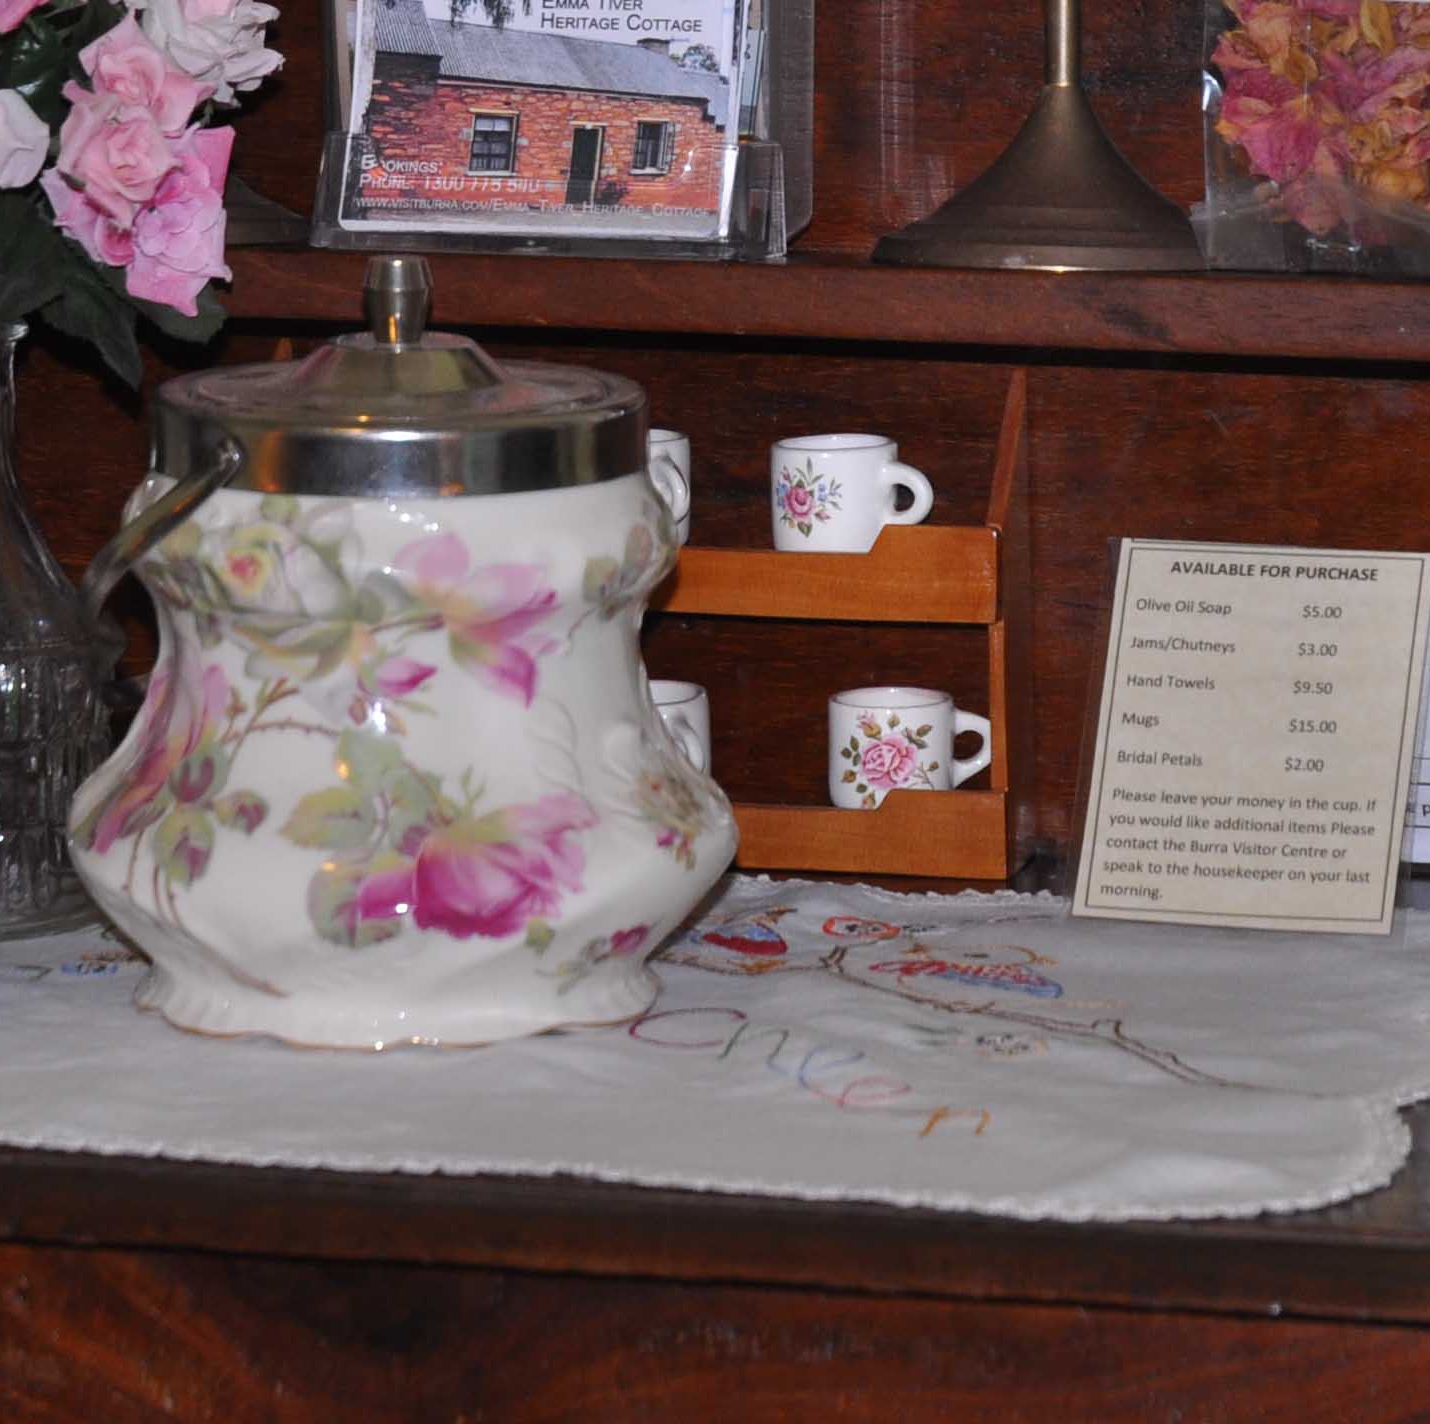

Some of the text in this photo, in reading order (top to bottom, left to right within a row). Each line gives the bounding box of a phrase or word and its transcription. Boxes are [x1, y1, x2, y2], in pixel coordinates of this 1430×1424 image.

[1171, 561, 1379, 581] AVAILABLE FOR PURCHASE
[1136, 598, 1342, 620] Olive Oil Soap $5.00
[1131, 636, 1338, 657] Jams/Chutneys $3.00
[1126, 675, 1333, 695] Hand Towels $9.50
[1122, 712, 1337, 734] Mugs $15.00
[1117, 751, 1324, 773] Bridal Petals $2.00
[1113, 787, 1377, 814] Please leave your money in the cup. If
[1109, 814, 1376, 836] you would like additional items Please
[1106, 837, 1347, 859] contact the Burra Visitor Centre or
[1103, 860, 1371, 884] speak to the housekeeper on your last
[1100, 884, 1163, 901] morning.
